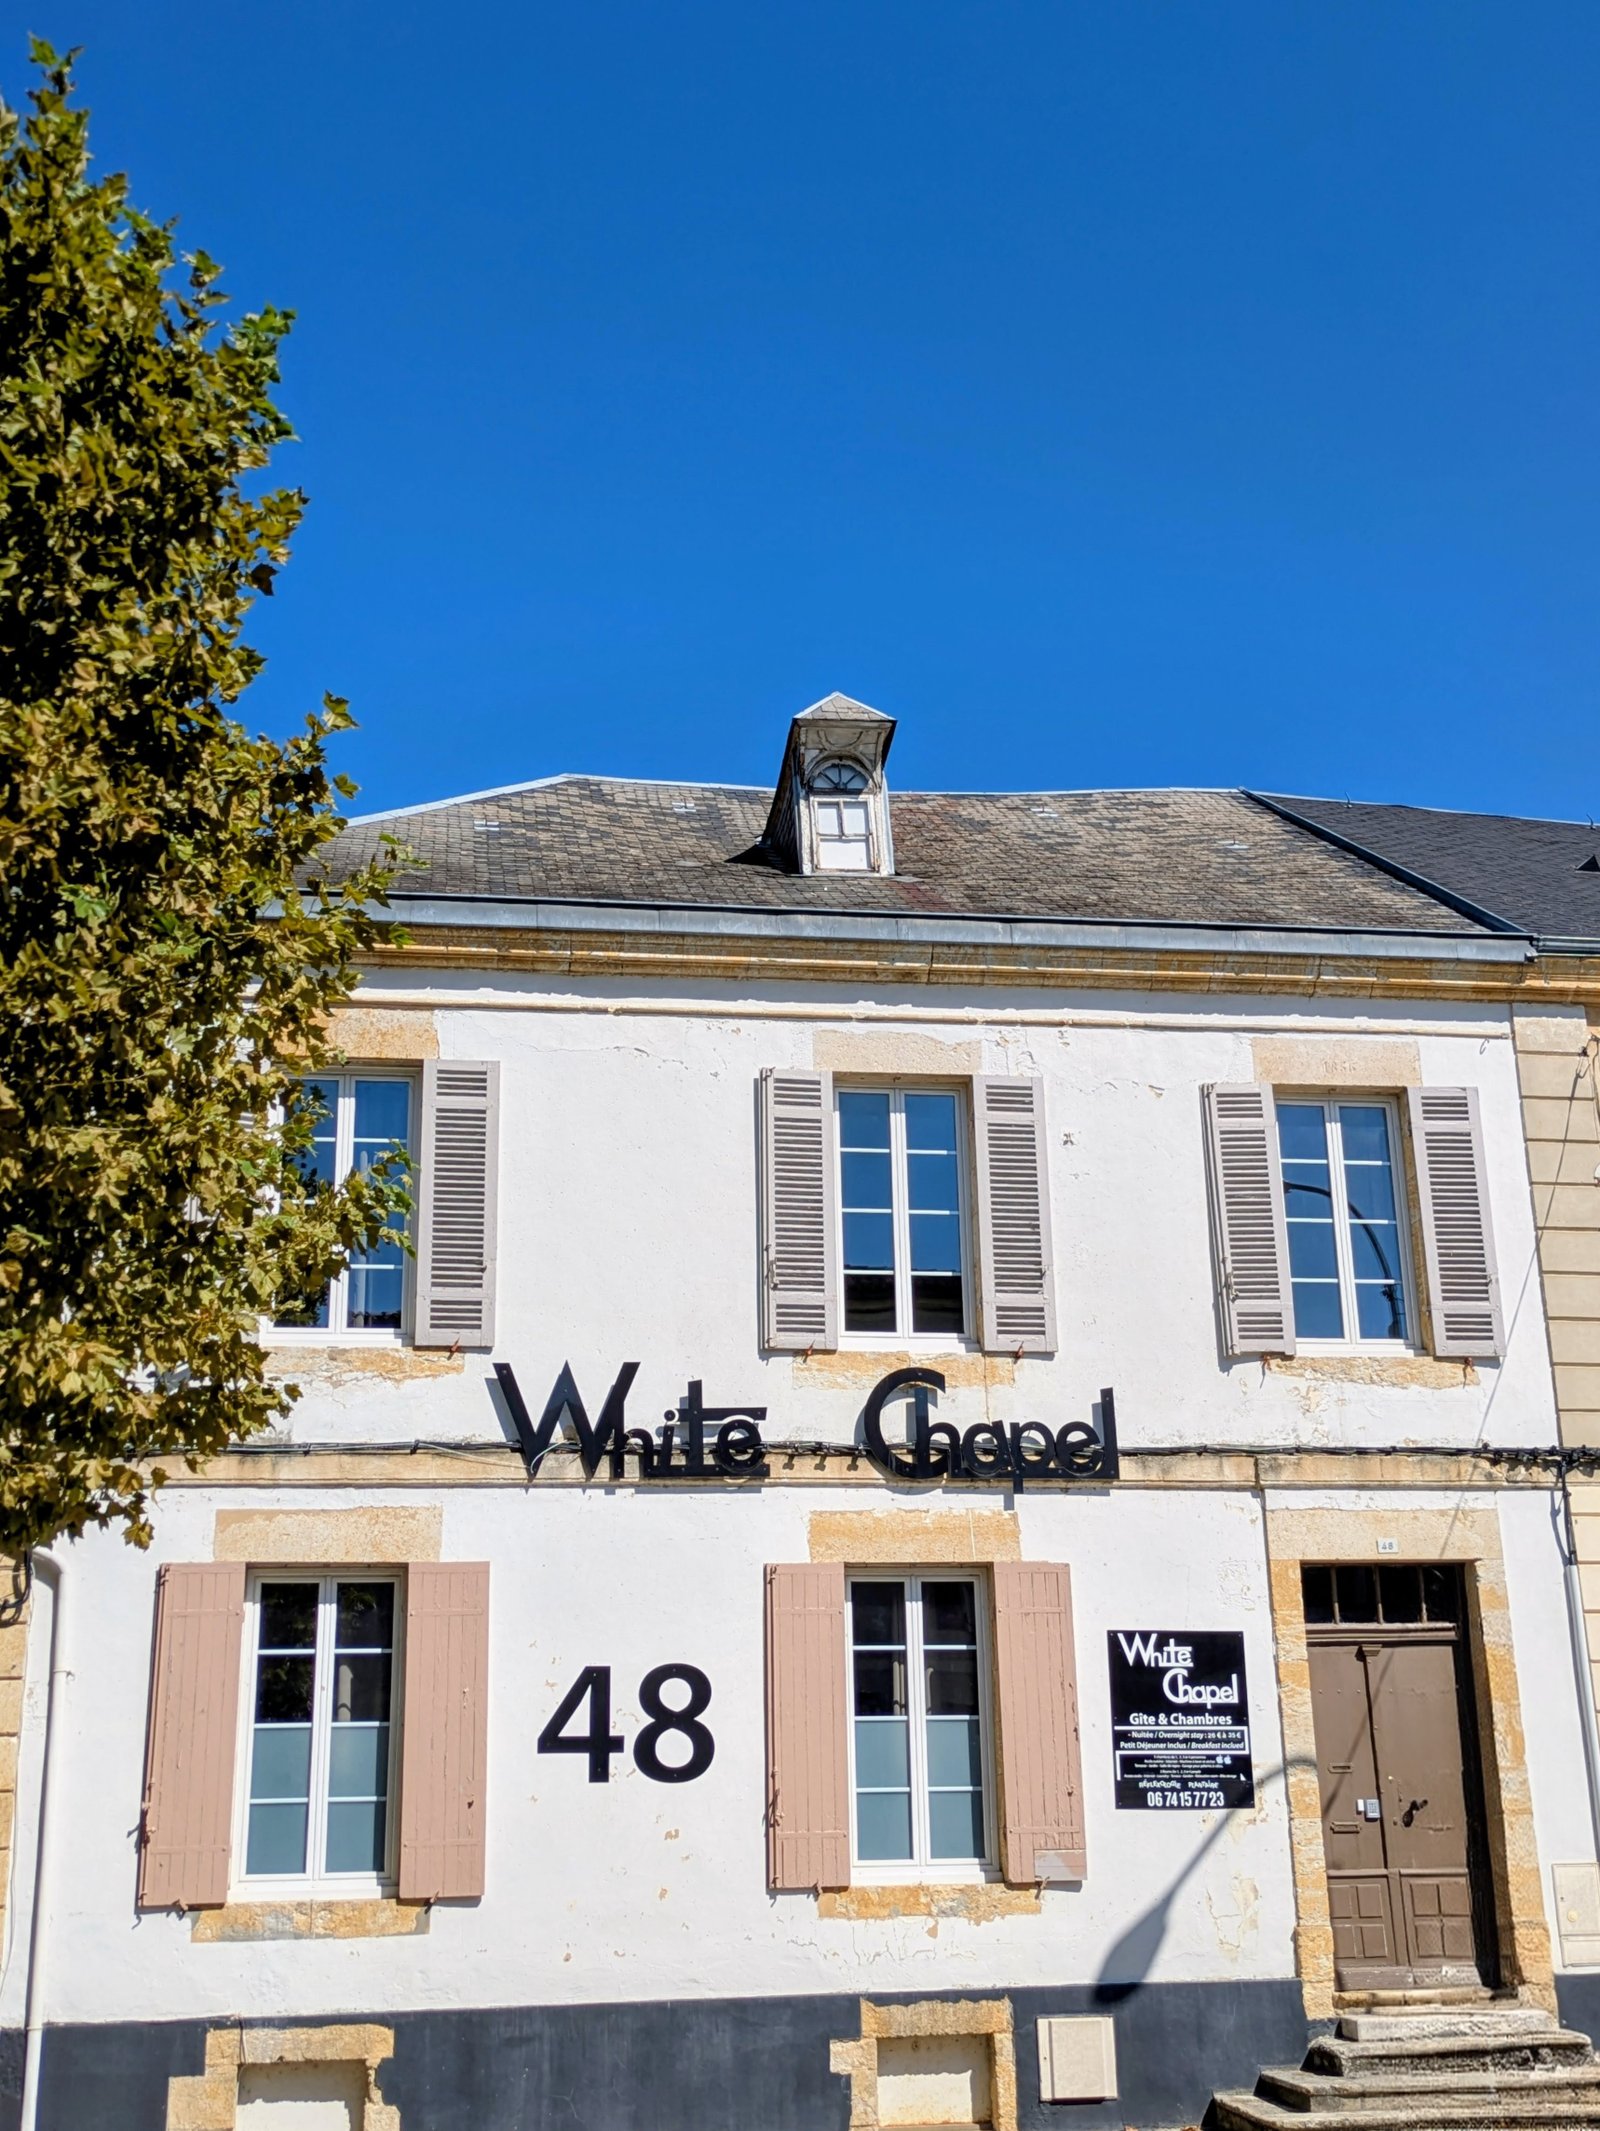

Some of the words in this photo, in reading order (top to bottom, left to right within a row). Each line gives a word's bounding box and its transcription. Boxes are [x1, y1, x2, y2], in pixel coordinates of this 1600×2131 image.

[492, 1360, 770, 1482] White
[864, 1366, 1119, 1494] Chapel
[1117, 1632, 1193, 1667] White
[1163, 1667, 1239, 1709] Chapel
[537, 1662, 715, 1783] 48
[1129, 1712, 1156, 1725] Gîte
[1158, 1713, 1168, 1725] &
[1170, 1712, 1232, 1725] Chambres
[1158, 1731, 1190, 1740] Overnight
[1120, 1741, 1136, 1749] Petit
[1136, 1741, 1166, 1750] Déjeuner
[1191, 1741, 1220, 1749] Breakfast
